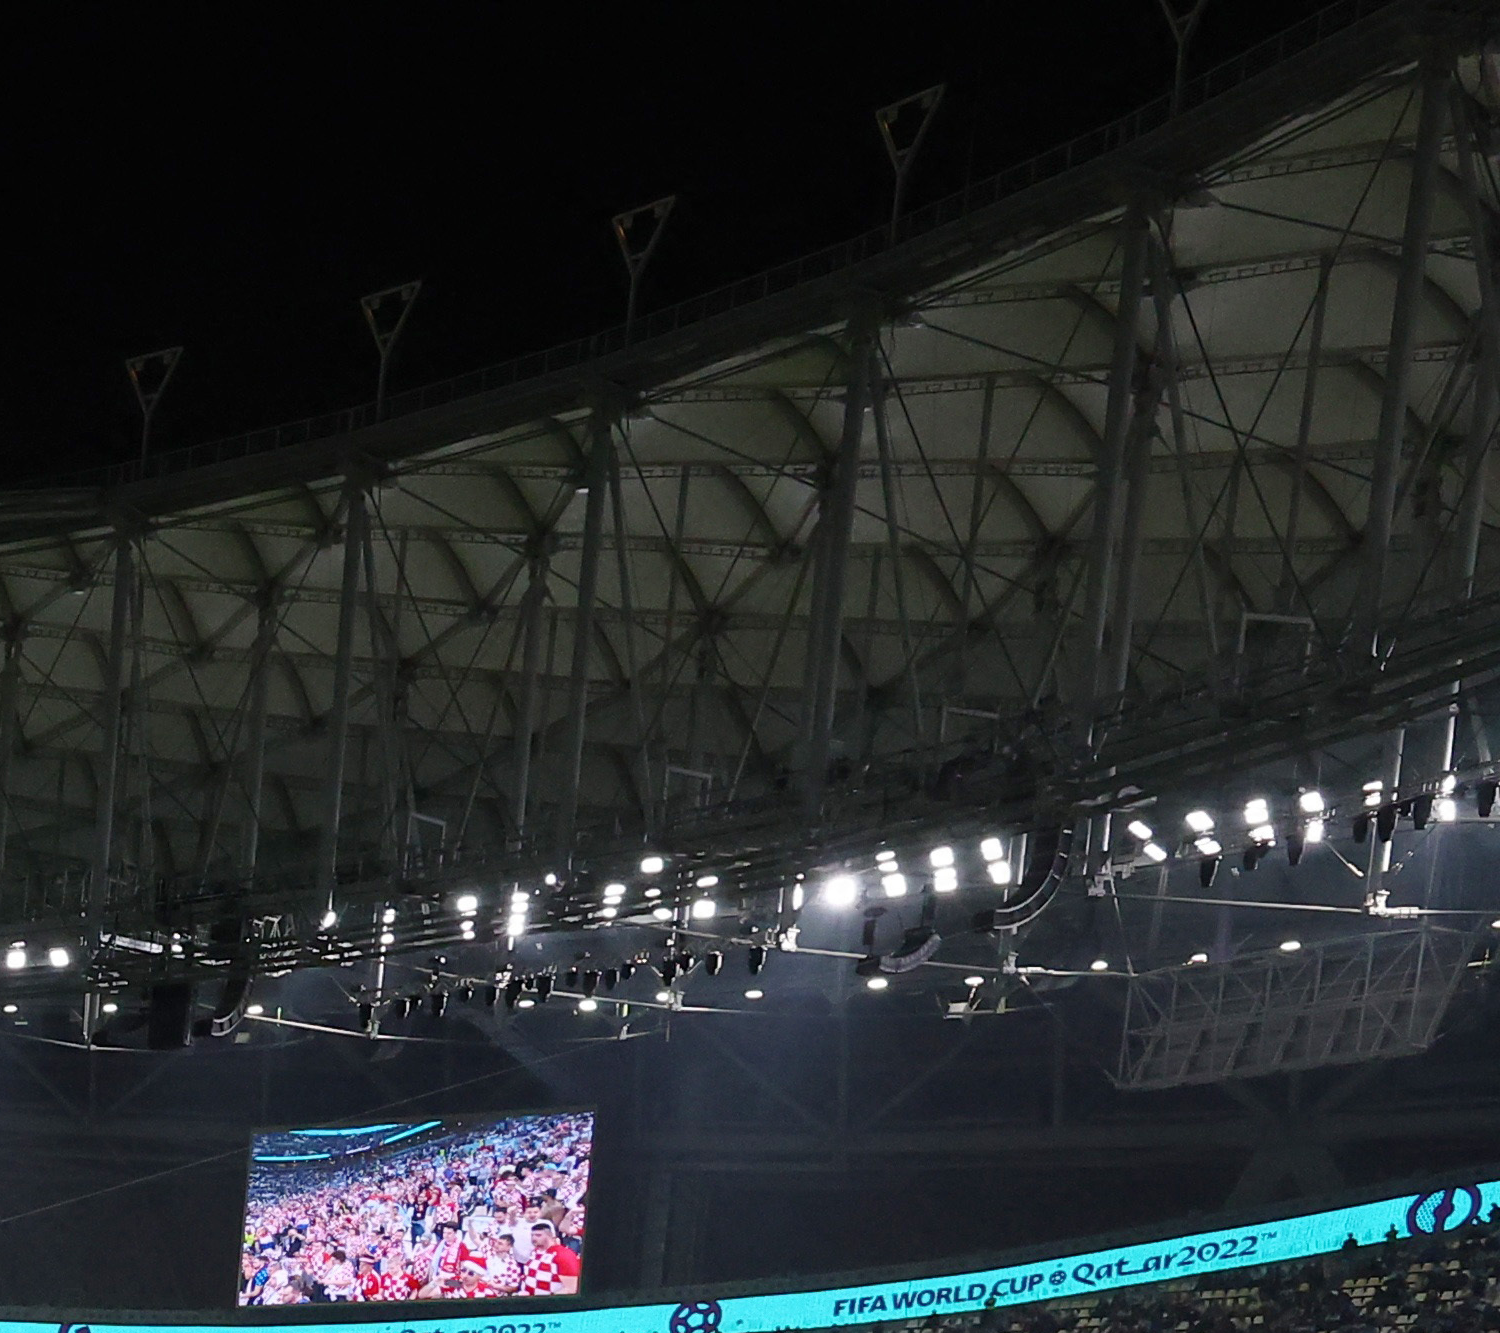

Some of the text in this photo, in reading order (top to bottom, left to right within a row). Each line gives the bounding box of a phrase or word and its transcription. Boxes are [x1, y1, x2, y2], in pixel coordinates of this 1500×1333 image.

[833, 1296, 886, 1317] FIFA
[892, 1285, 984, 1311] WORLD
[993, 1274, 1043, 1296] CUP
